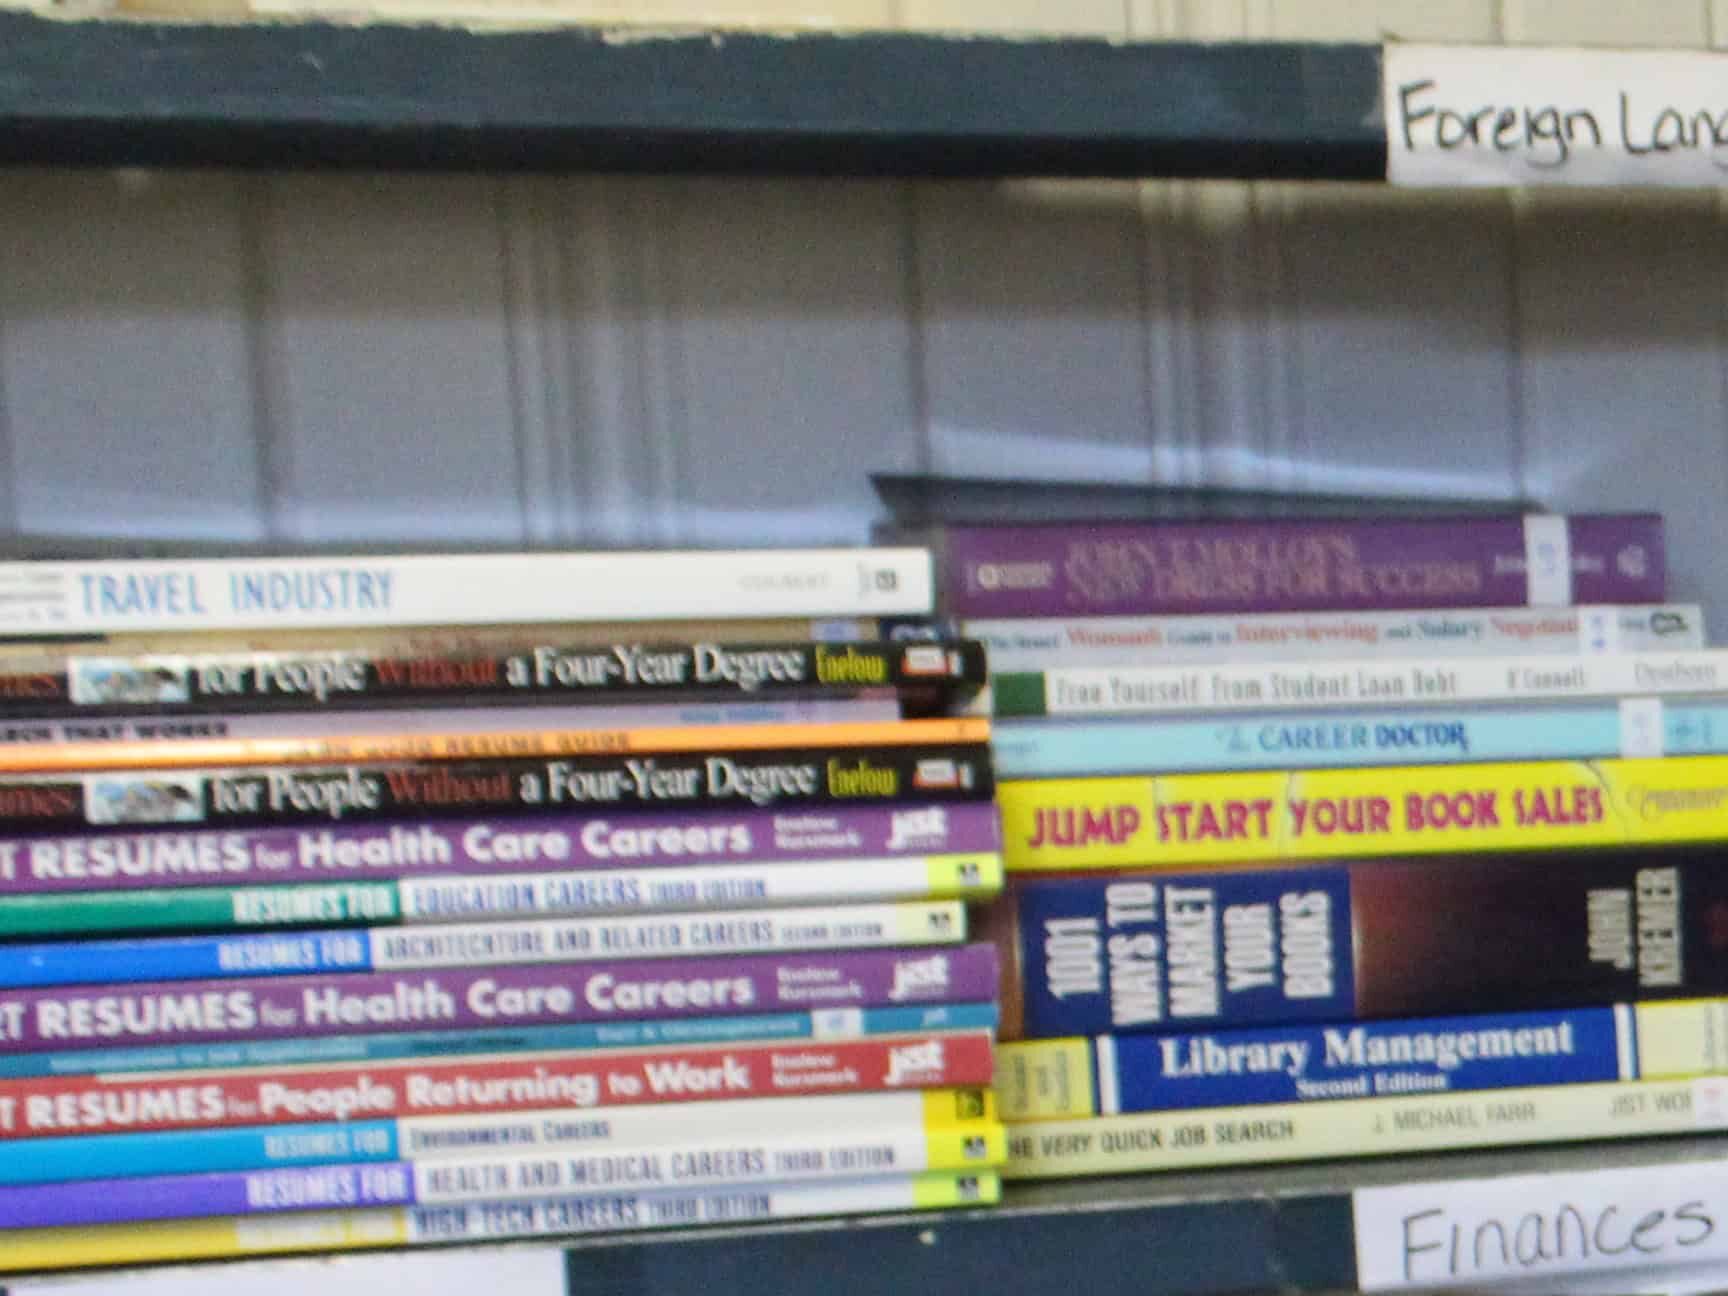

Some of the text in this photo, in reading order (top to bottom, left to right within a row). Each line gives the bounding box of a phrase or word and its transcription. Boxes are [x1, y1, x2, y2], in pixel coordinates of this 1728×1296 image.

[1398, 78, 1603, 171] Foreign
[77, 568, 398, 615] TRAVEL INDUSTRY
[200, 657, 248, 697] for
[253, 651, 367, 701] People
[374, 655, 498, 687] Without
[506, 655, 529, 676] a
[534, 643, 685, 686] Four-Year
[694, 643, 804, 690] Degree
[1056, 678, 1098, 704] Free
[1109, 674, 1198, 702] Yourself
[1271, 669, 1351, 698] Student
[1358, 671, 1404, 694] Loan
[1258, 721, 1469, 753] CAREER DOCTOR
[211, 774, 262, 814] for
[267, 769, 380, 819] People
[387, 769, 512, 802] Without
[520, 772, 543, 800] a
[549, 760, 698, 802] Four-Year
[706, 756, 817, 806] Degree
[1028, 784, 1605, 849] JUMP START YOUR BOOK SALES
[32, 836, 251, 880] RESUMES
[299, 828, 452, 870] Health
[462, 821, 572, 862] Care
[580, 819, 752, 861] Careers
[1222, 903, 1275, 992] YOUR
[1279, 890, 1334, 998] BOOKS
[37, 991, 256, 1039] RESUMES
[304, 981, 454, 1024] Health
[467, 978, 575, 1016] Care
[585, 973, 756, 1011] Careers
[1159, 1020, 1576, 1078] Library Management
[27, 1057, 752, 1129] RESUMES People Returning to Work
[1297, 1069, 1447, 1098] Second Edition
[1401, 1198, 1715, 1282] Finances
